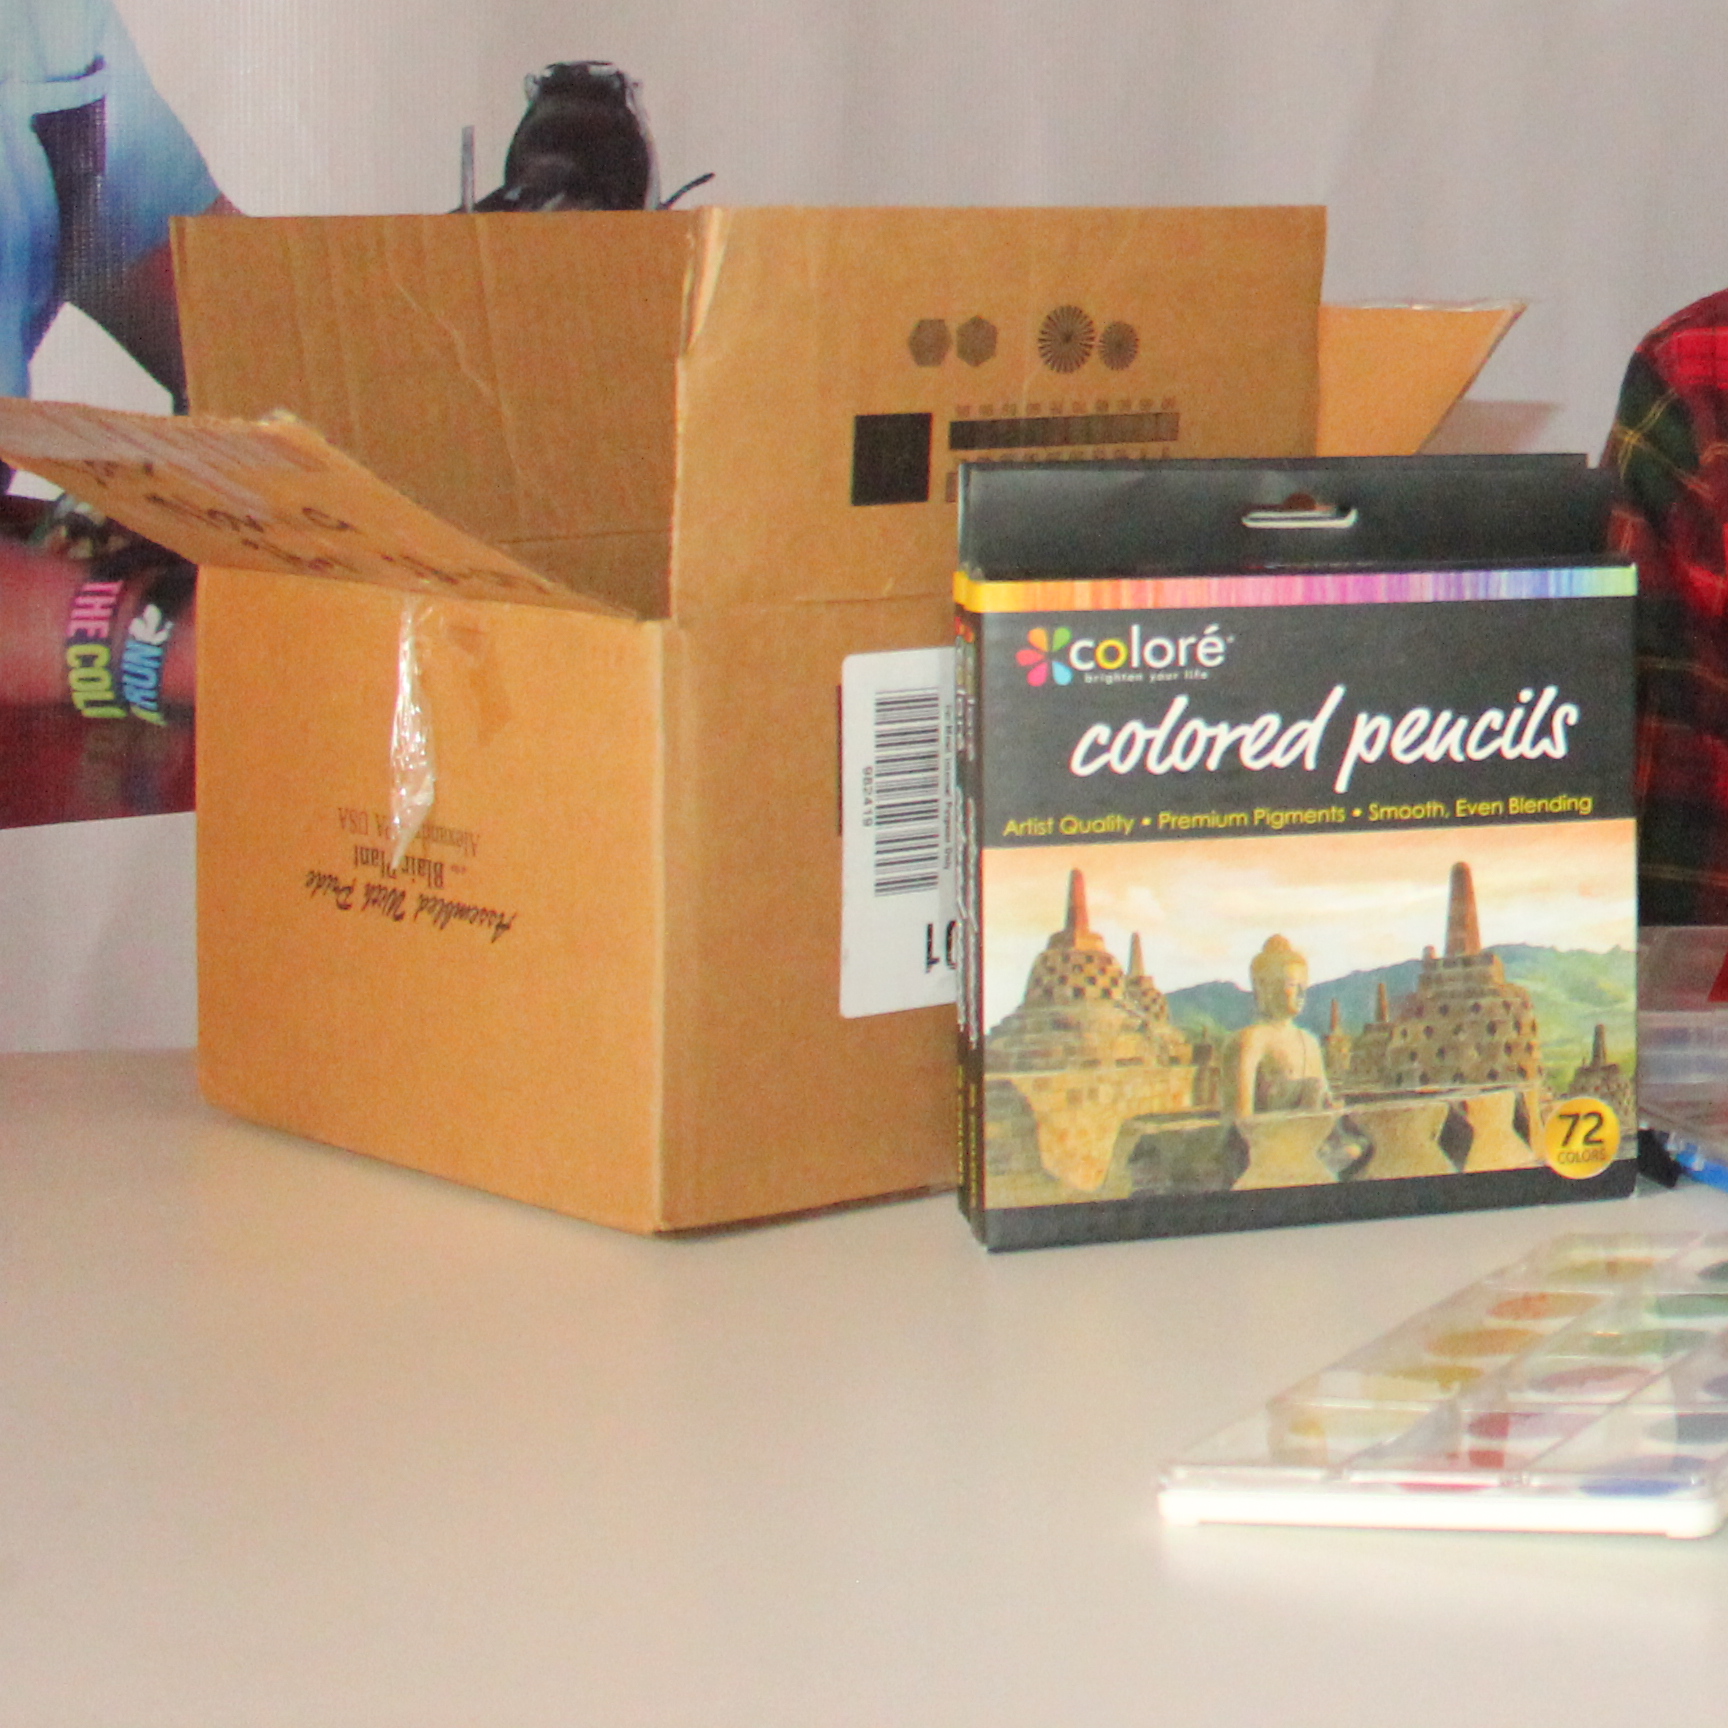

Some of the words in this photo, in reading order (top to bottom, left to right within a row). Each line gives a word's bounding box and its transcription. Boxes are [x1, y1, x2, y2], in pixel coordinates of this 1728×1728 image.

[66, 580, 124, 639] THE
[1069, 623, 1227, 671] coloré
[1084, 671, 1144, 686] brighten
[1149, 669, 1180, 683] your
[1183, 667, 1209, 680] life
[1070, 684, 1346, 778] colored
[1334, 683, 1581, 793] pencils
[862, 765, 874, 828] 982419
[1003, 816, 1053, 836] Artist
[1059, 815, 1136, 835] Quality
[1157, 809, 1249, 830] Premium
[1253, 806, 1347, 830] Pigments
[1368, 800, 1451, 822] Smooth,
[1455, 798, 1504, 818] Even
[1508, 794, 1594, 816] Blending
[338, 807, 369, 836] USA
[304, 869, 358, 911] Pride
[401, 854, 445, 890] Blair
[361, 881, 407, 923] With
[413, 892, 518, 944] Assembled
[1558, 1111, 1605, 1148] 72
[1556, 1148, 1607, 1165] COLORS
